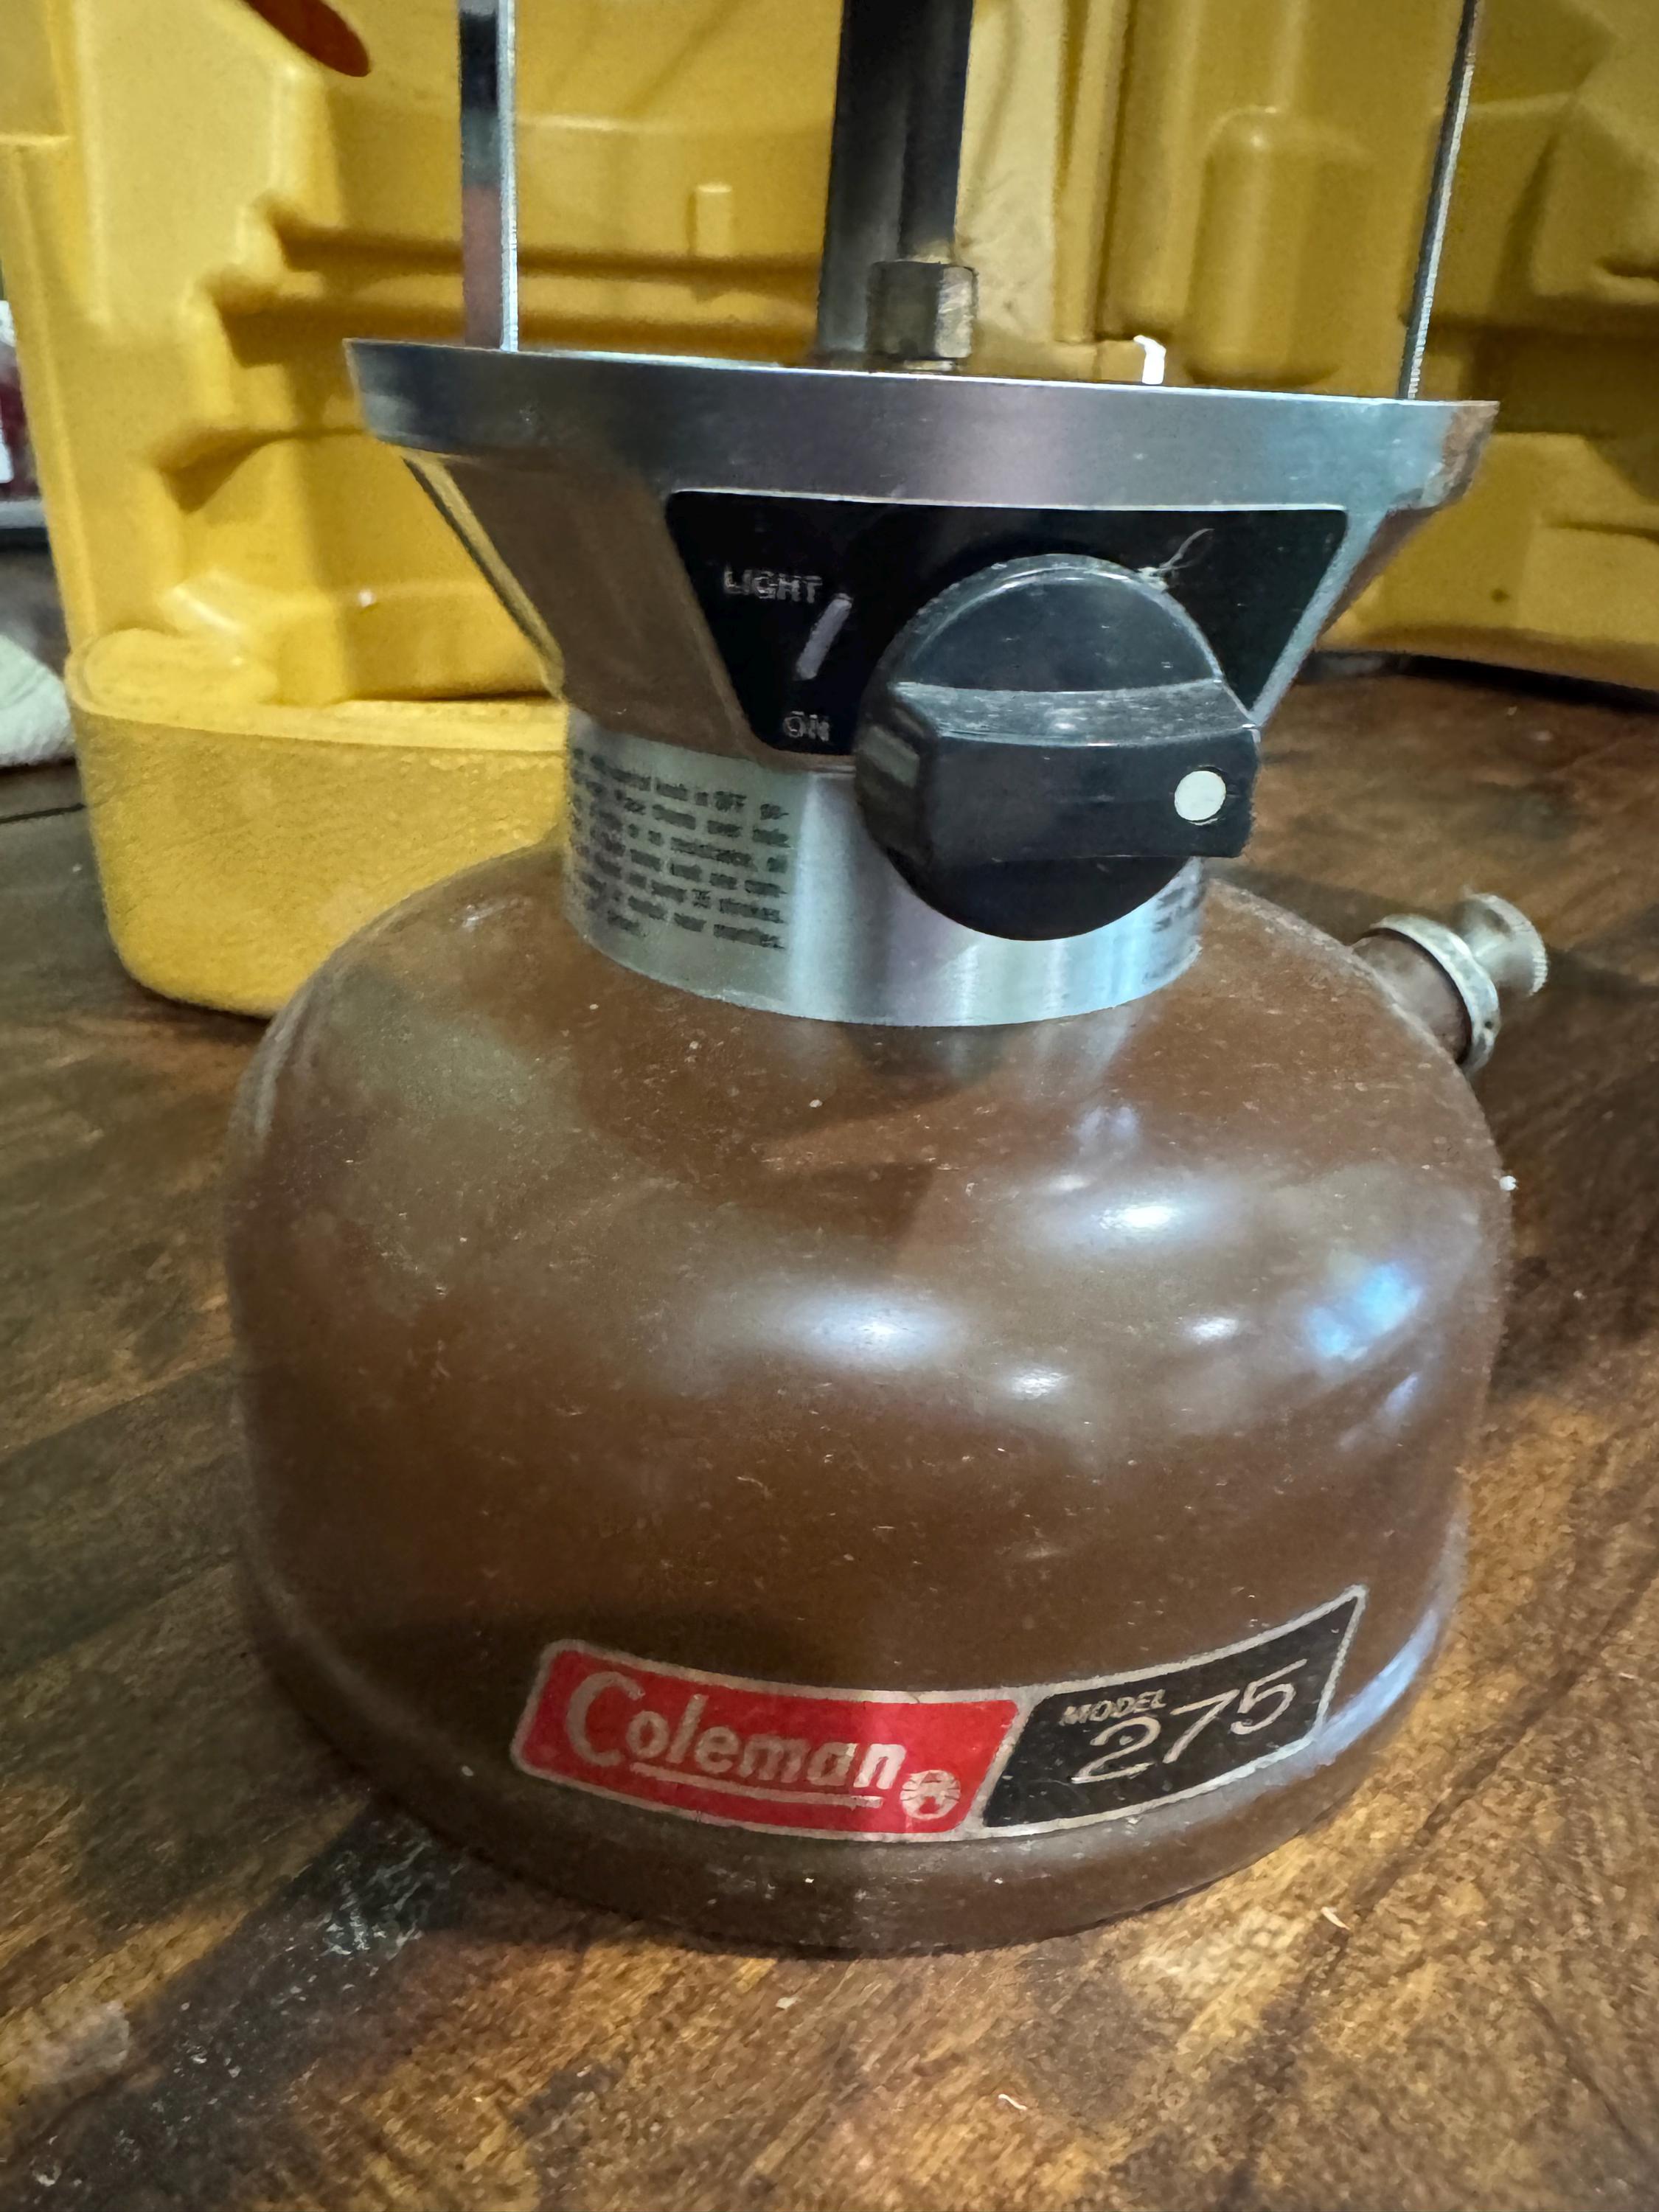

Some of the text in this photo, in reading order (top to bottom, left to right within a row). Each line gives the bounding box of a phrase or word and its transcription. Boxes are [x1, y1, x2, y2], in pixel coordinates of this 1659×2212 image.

[724, 568, 823, 603] LIGHT
[783, 710, 830, 742] ON
[1059, 1688, 1166, 1726] MODEL
[1070, 1658, 1309, 1784] 275
[566, 1671, 907, 1790] Coleman
